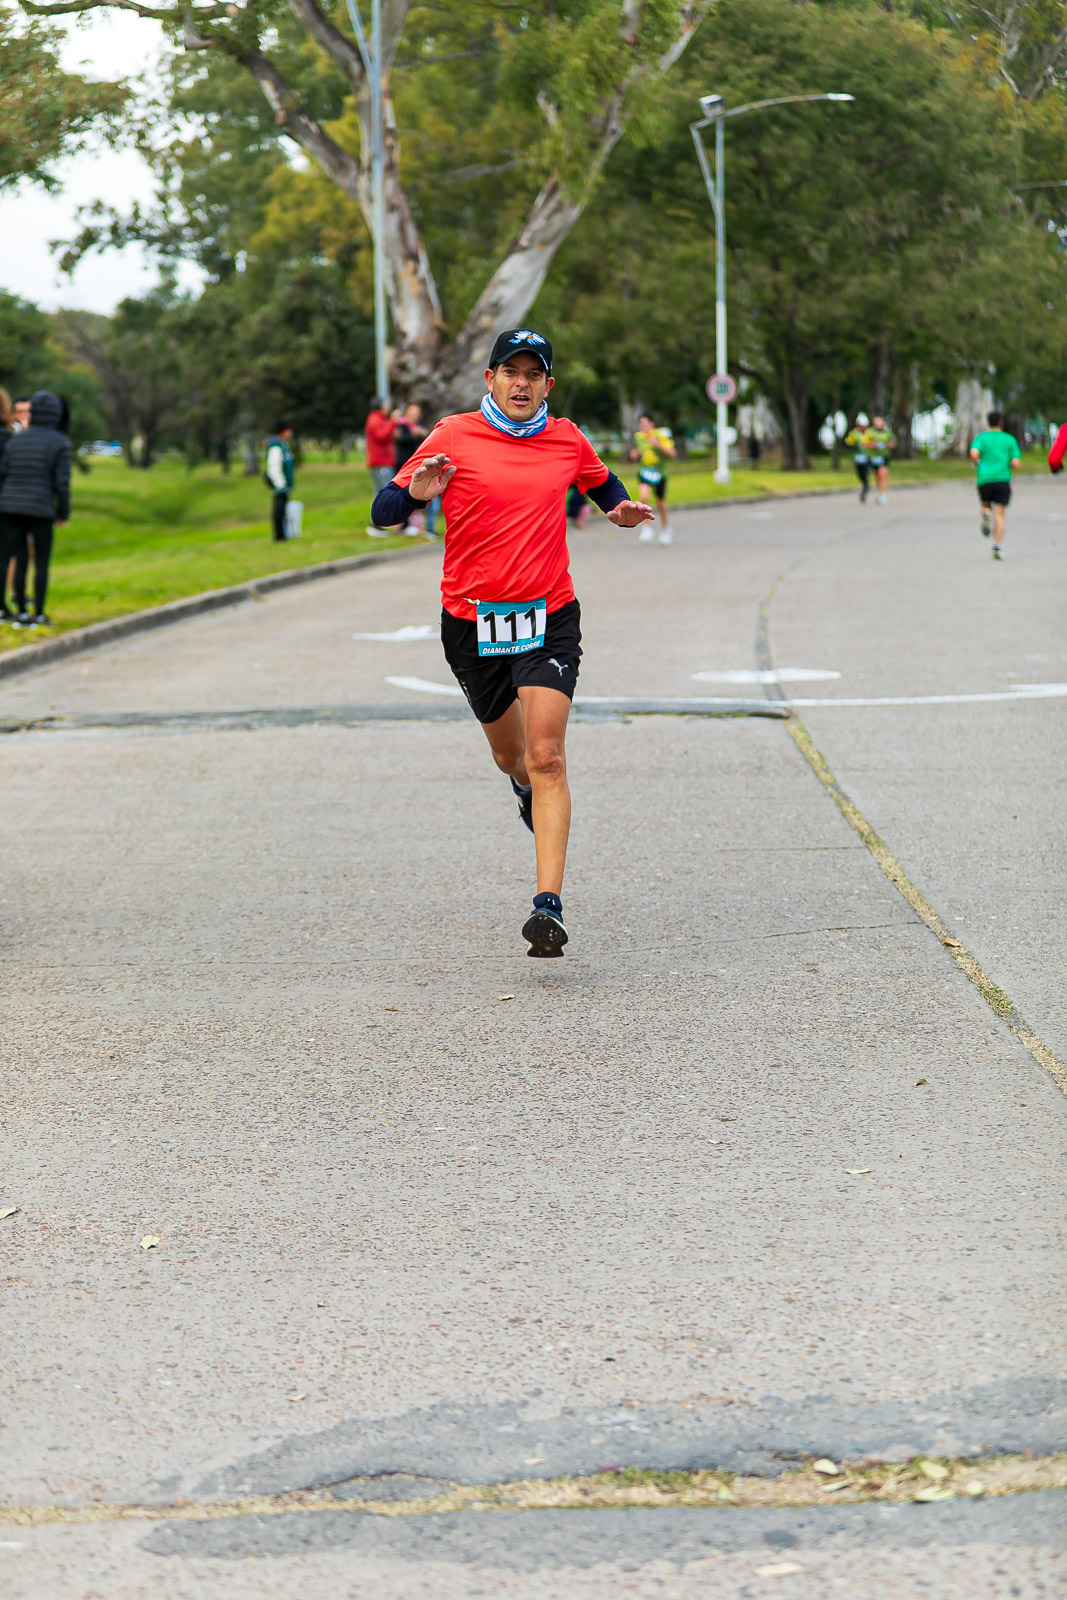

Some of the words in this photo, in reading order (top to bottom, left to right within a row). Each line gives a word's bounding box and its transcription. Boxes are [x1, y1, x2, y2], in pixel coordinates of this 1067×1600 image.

[483, 607, 536, 644] 111
[482, 646, 519, 654] DIAMANTE
[521, 640, 540, 651] CORRE
